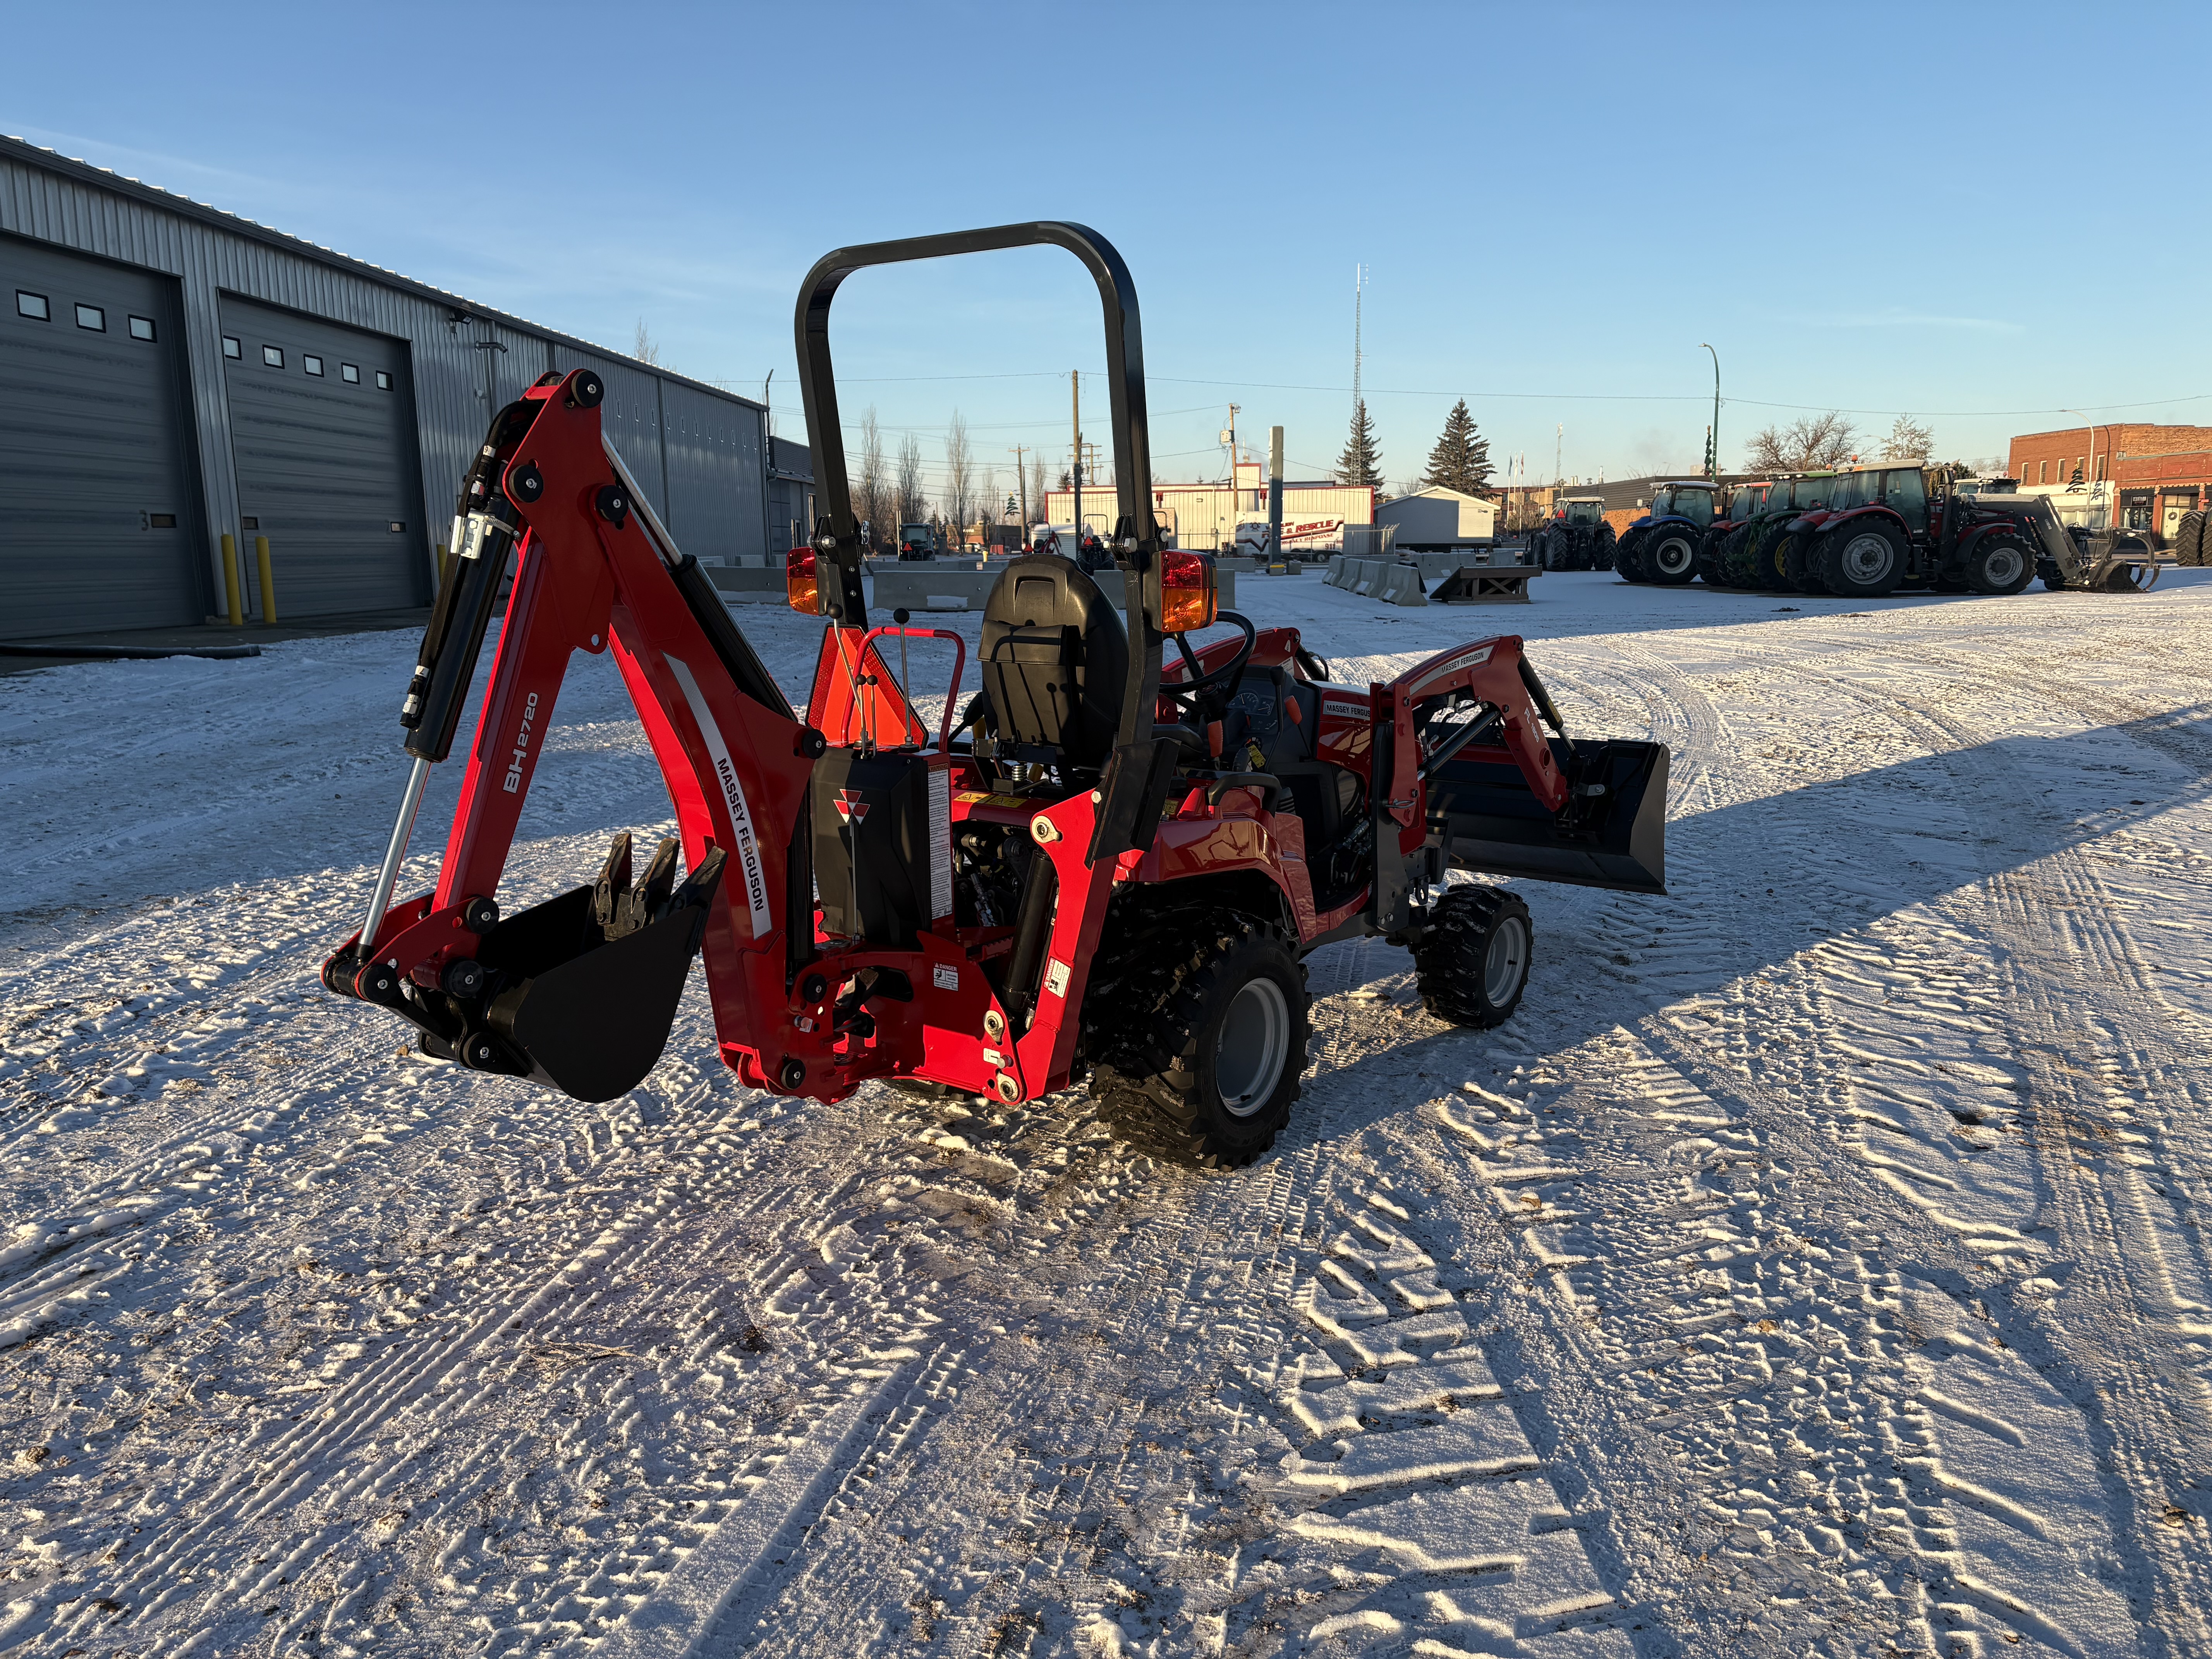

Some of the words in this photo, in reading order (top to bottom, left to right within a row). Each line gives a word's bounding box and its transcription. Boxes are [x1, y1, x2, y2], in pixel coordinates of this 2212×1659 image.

[139, 509, 149, 531] 3
[1296, 520, 1333, 532] RESCUE
[1305, 533, 1333, 541] RESPONSE
[1441, 659, 1460, 673] MASSEY
[1461, 651, 1484, 665] FERGUSON
[1327, 704, 1349, 713] MASSEY
[1351, 707, 1370, 717] FERGUS
[1524, 707, 1530, 724] FL
[718, 757, 745, 821] MASSEY
[739, 826, 764, 911] FERGUSON
[939, 963, 957, 972] DANGER
[1045, 958, 1055, 981] DANGER
